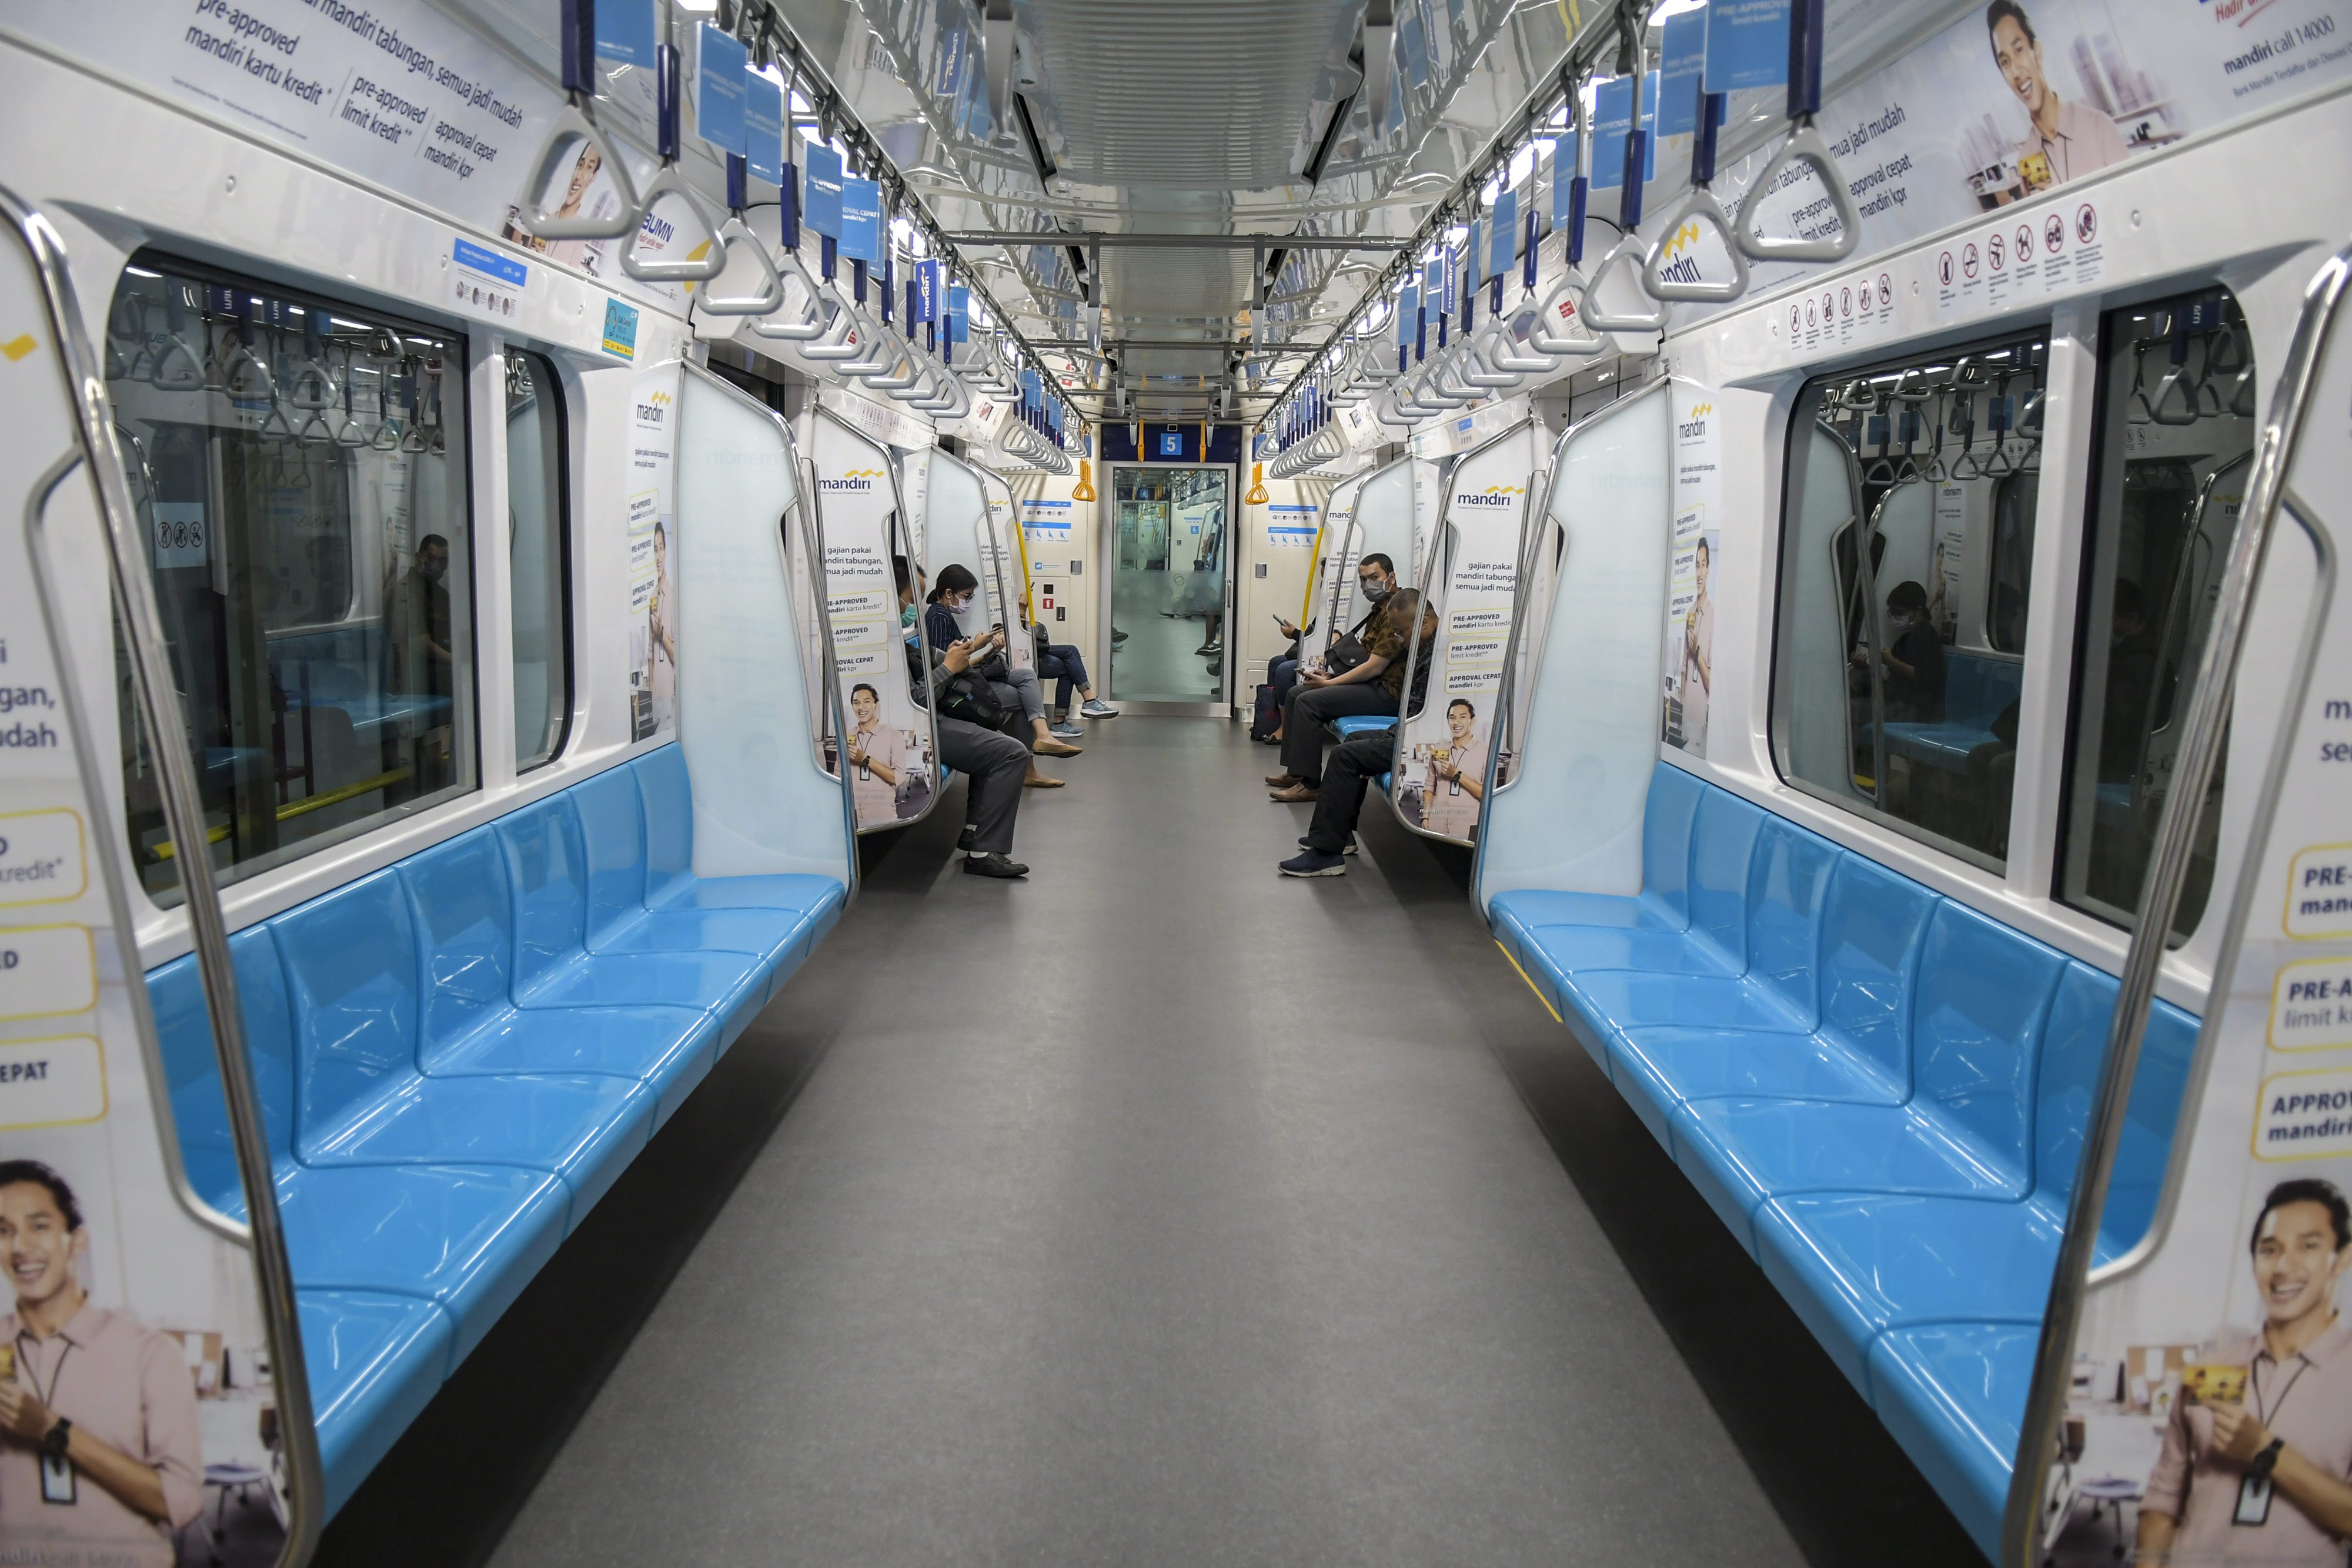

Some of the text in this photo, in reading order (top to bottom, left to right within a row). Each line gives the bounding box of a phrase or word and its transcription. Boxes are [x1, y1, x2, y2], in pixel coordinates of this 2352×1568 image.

[1716, 1, 1789, 16] PRE-APPROVE
[196, 0, 300, 56] pre-approved
[185, 25, 246, 66] mandiri
[243, 48, 283, 85] kartu
[2224, 15, 2335, 75] mandiri call 14000
[320, 0, 522, 129] mandiri tabungan, semua jadi mudah
[351, 76, 429, 125] pre-approved
[340, 98, 370, 129] limit
[1641, 113, 1653, 122] PAT
[435, 121, 497, 162] approval cepat
[1779, 102, 1906, 188] tabunga mua jadi mudah
[423, 146, 475, 180] mandiri kpr
[1849, 153, 1912, 198] approval cepat
[860, 209, 877, 218] CEPAT
[1792, 195, 1832, 225] pre-approv
[1859, 187, 1907, 219] mandiri kpr
[642, 212, 674, 243] BUMN
[1799, 215, 1842, 241] limit kredit
[637, 402, 663, 423] mandiri
[1679, 416, 1705, 439] mandiri
[1167, 436, 1176, 452] 5
[819, 477, 870, 489] mandiri
[1458, 493, 1511, 506] mandiri
[827, 547, 871, 555] gajian pakai
[841, 568, 855, 576] jadi
[1468, 562, 1512, 571] gajian pakai
[1486, 574, 1516, 582] tabunga
[1481, 583, 1494, 592] jadi
[1454, 614, 1500, 622] PRE-APPROVED
[1452, 643, 1498, 651] PRE-APPROVED
[2284, 1008, 2333, 1028] limit
[2268, 1118, 2352, 1142] mandiri
